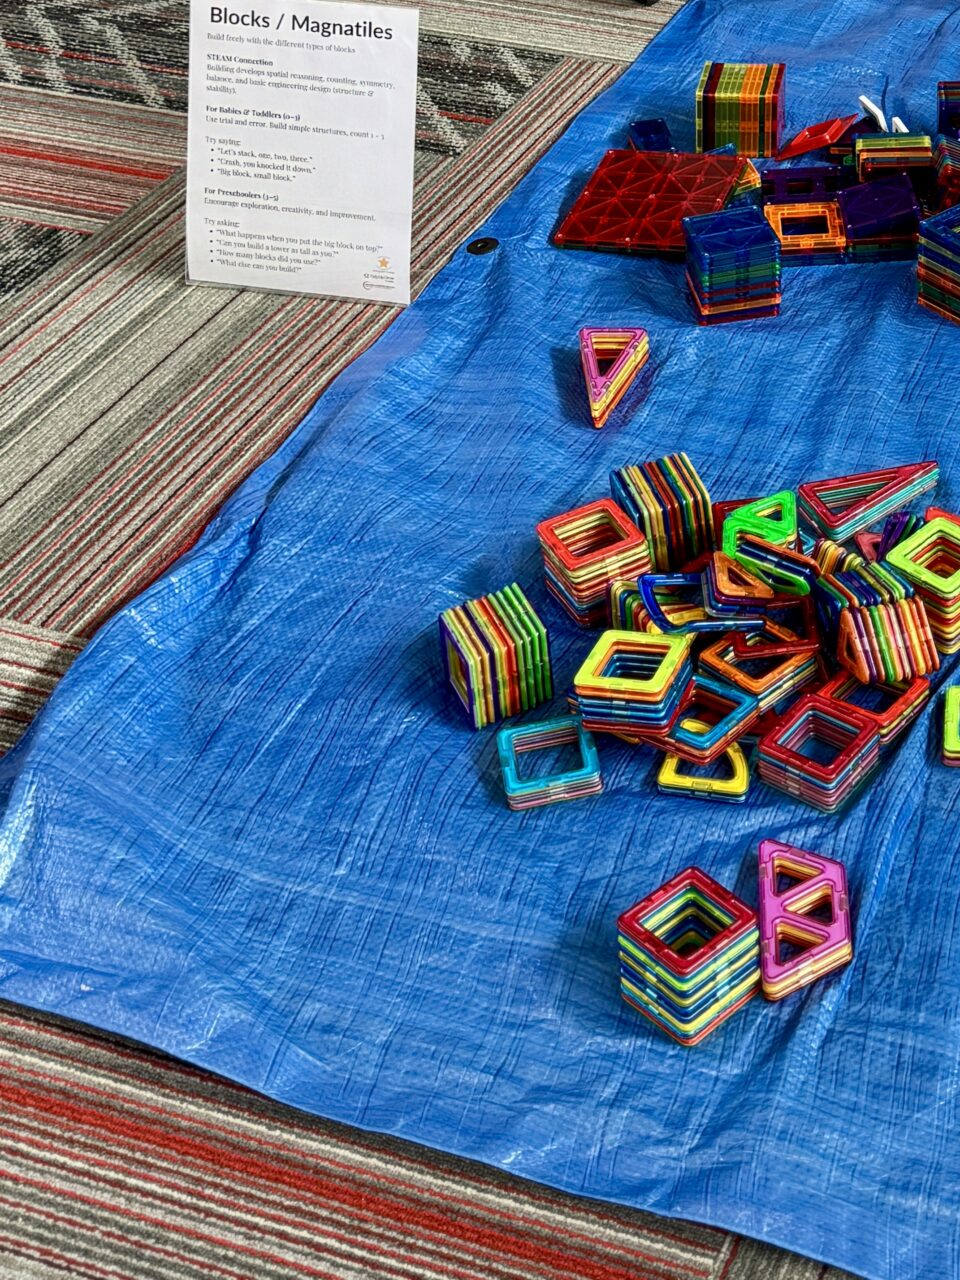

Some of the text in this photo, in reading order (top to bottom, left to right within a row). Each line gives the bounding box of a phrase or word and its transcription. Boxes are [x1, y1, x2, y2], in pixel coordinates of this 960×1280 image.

[211, 7, 392, 39] Blocks / Magnatiles
[227, 35, 244, 43] freely
[263, 38, 273, 46] the
[275, 40, 304, 48] different
[306, 43, 323, 51] types
[334, 45, 355, 53] blocks
[207, 54, 273, 66] STEAM Connection
[236, 67, 264, 76] develops
[268, 81, 307, 91] engineering
[310, 85, 331, 93] design
[252, 110, 281, 118] Toddlers
[220, 116, 233, 124] trial
[289, 124, 309, 133] simple
[350, 130, 369, 138] count
[206, 136, 216, 144] Try
[257, 162, 284, 170] knocked
[218, 189, 261, 198] Preschoolers
[204, 198, 239, 207] Encourage
[238, 231, 265, 240] happens
[271, 245, 289, 253] tower
[255, 253, 276, 261] blocks
